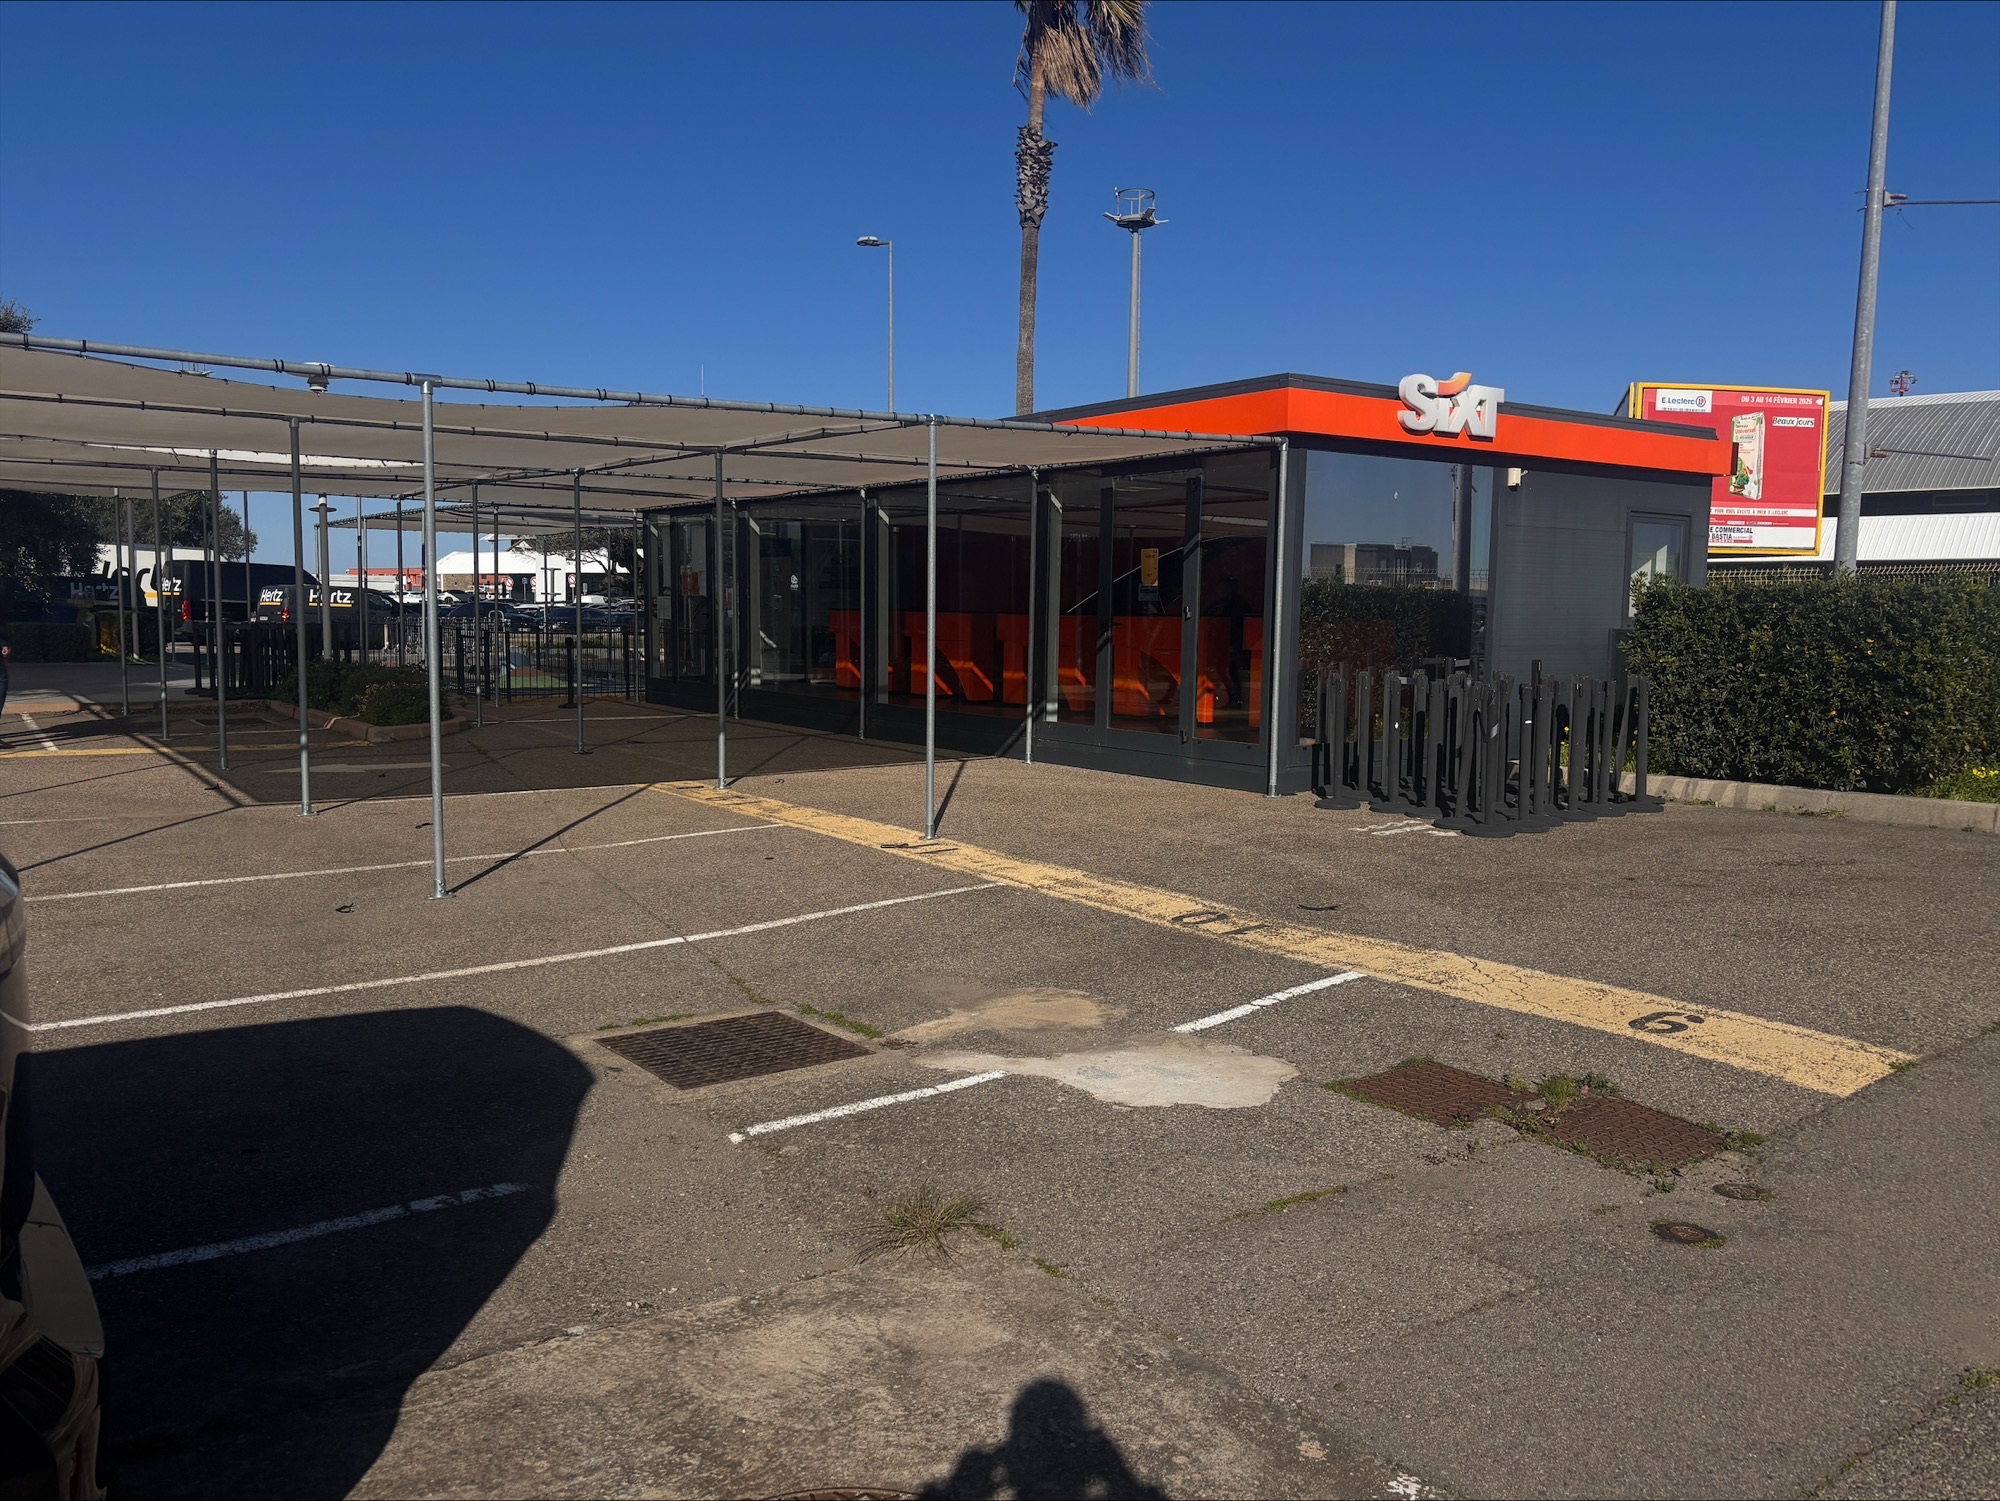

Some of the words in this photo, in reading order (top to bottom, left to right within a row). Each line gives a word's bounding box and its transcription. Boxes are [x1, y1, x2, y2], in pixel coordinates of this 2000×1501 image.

[1661, 396, 1695, 405] E.Leclerc
[1741, 395, 1750, 403] DU
[1765, 396, 1772, 404] 14
[1773, 395, 1798, 404] FÉVRIER
[1798, 397, 1813, 405] 2026
[1772, 417, 1794, 425] Beaux
[1794, 417, 1814, 428] jours
[260, 589, 283, 602] Hertz
[309, 589, 352, 604] Hrtz
